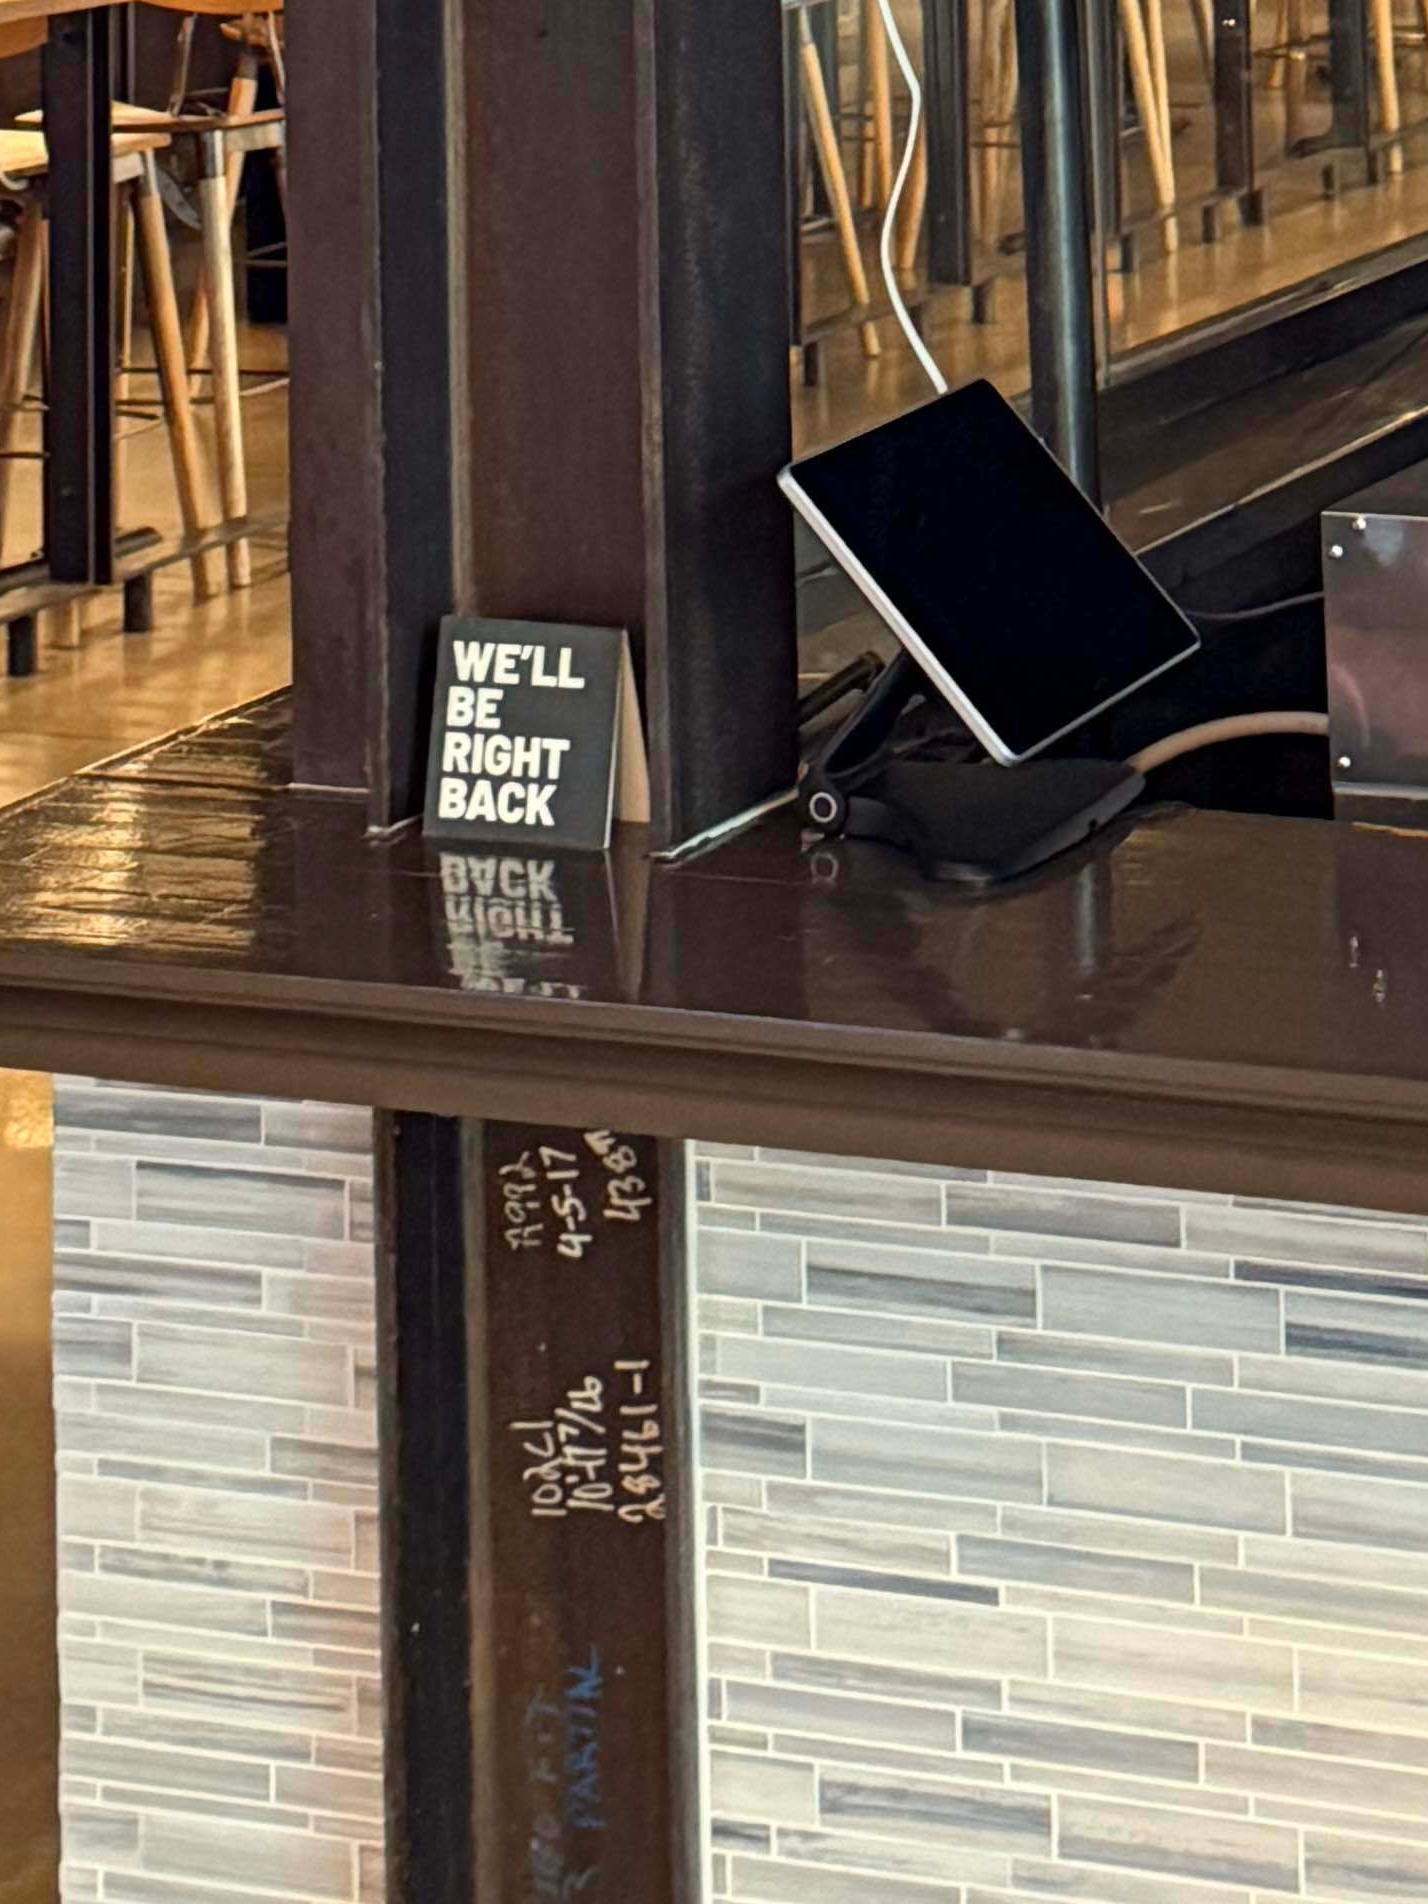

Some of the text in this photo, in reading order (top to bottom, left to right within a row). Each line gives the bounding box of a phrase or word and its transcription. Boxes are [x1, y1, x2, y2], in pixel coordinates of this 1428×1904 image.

[453, 640, 585, 689] WE'LL
[446, 686, 504, 729] BE
[442, 733, 571, 780] RIGHT
[438, 777, 557, 827] BACK
[539, 1145, 593, 1258] 4-5-17
